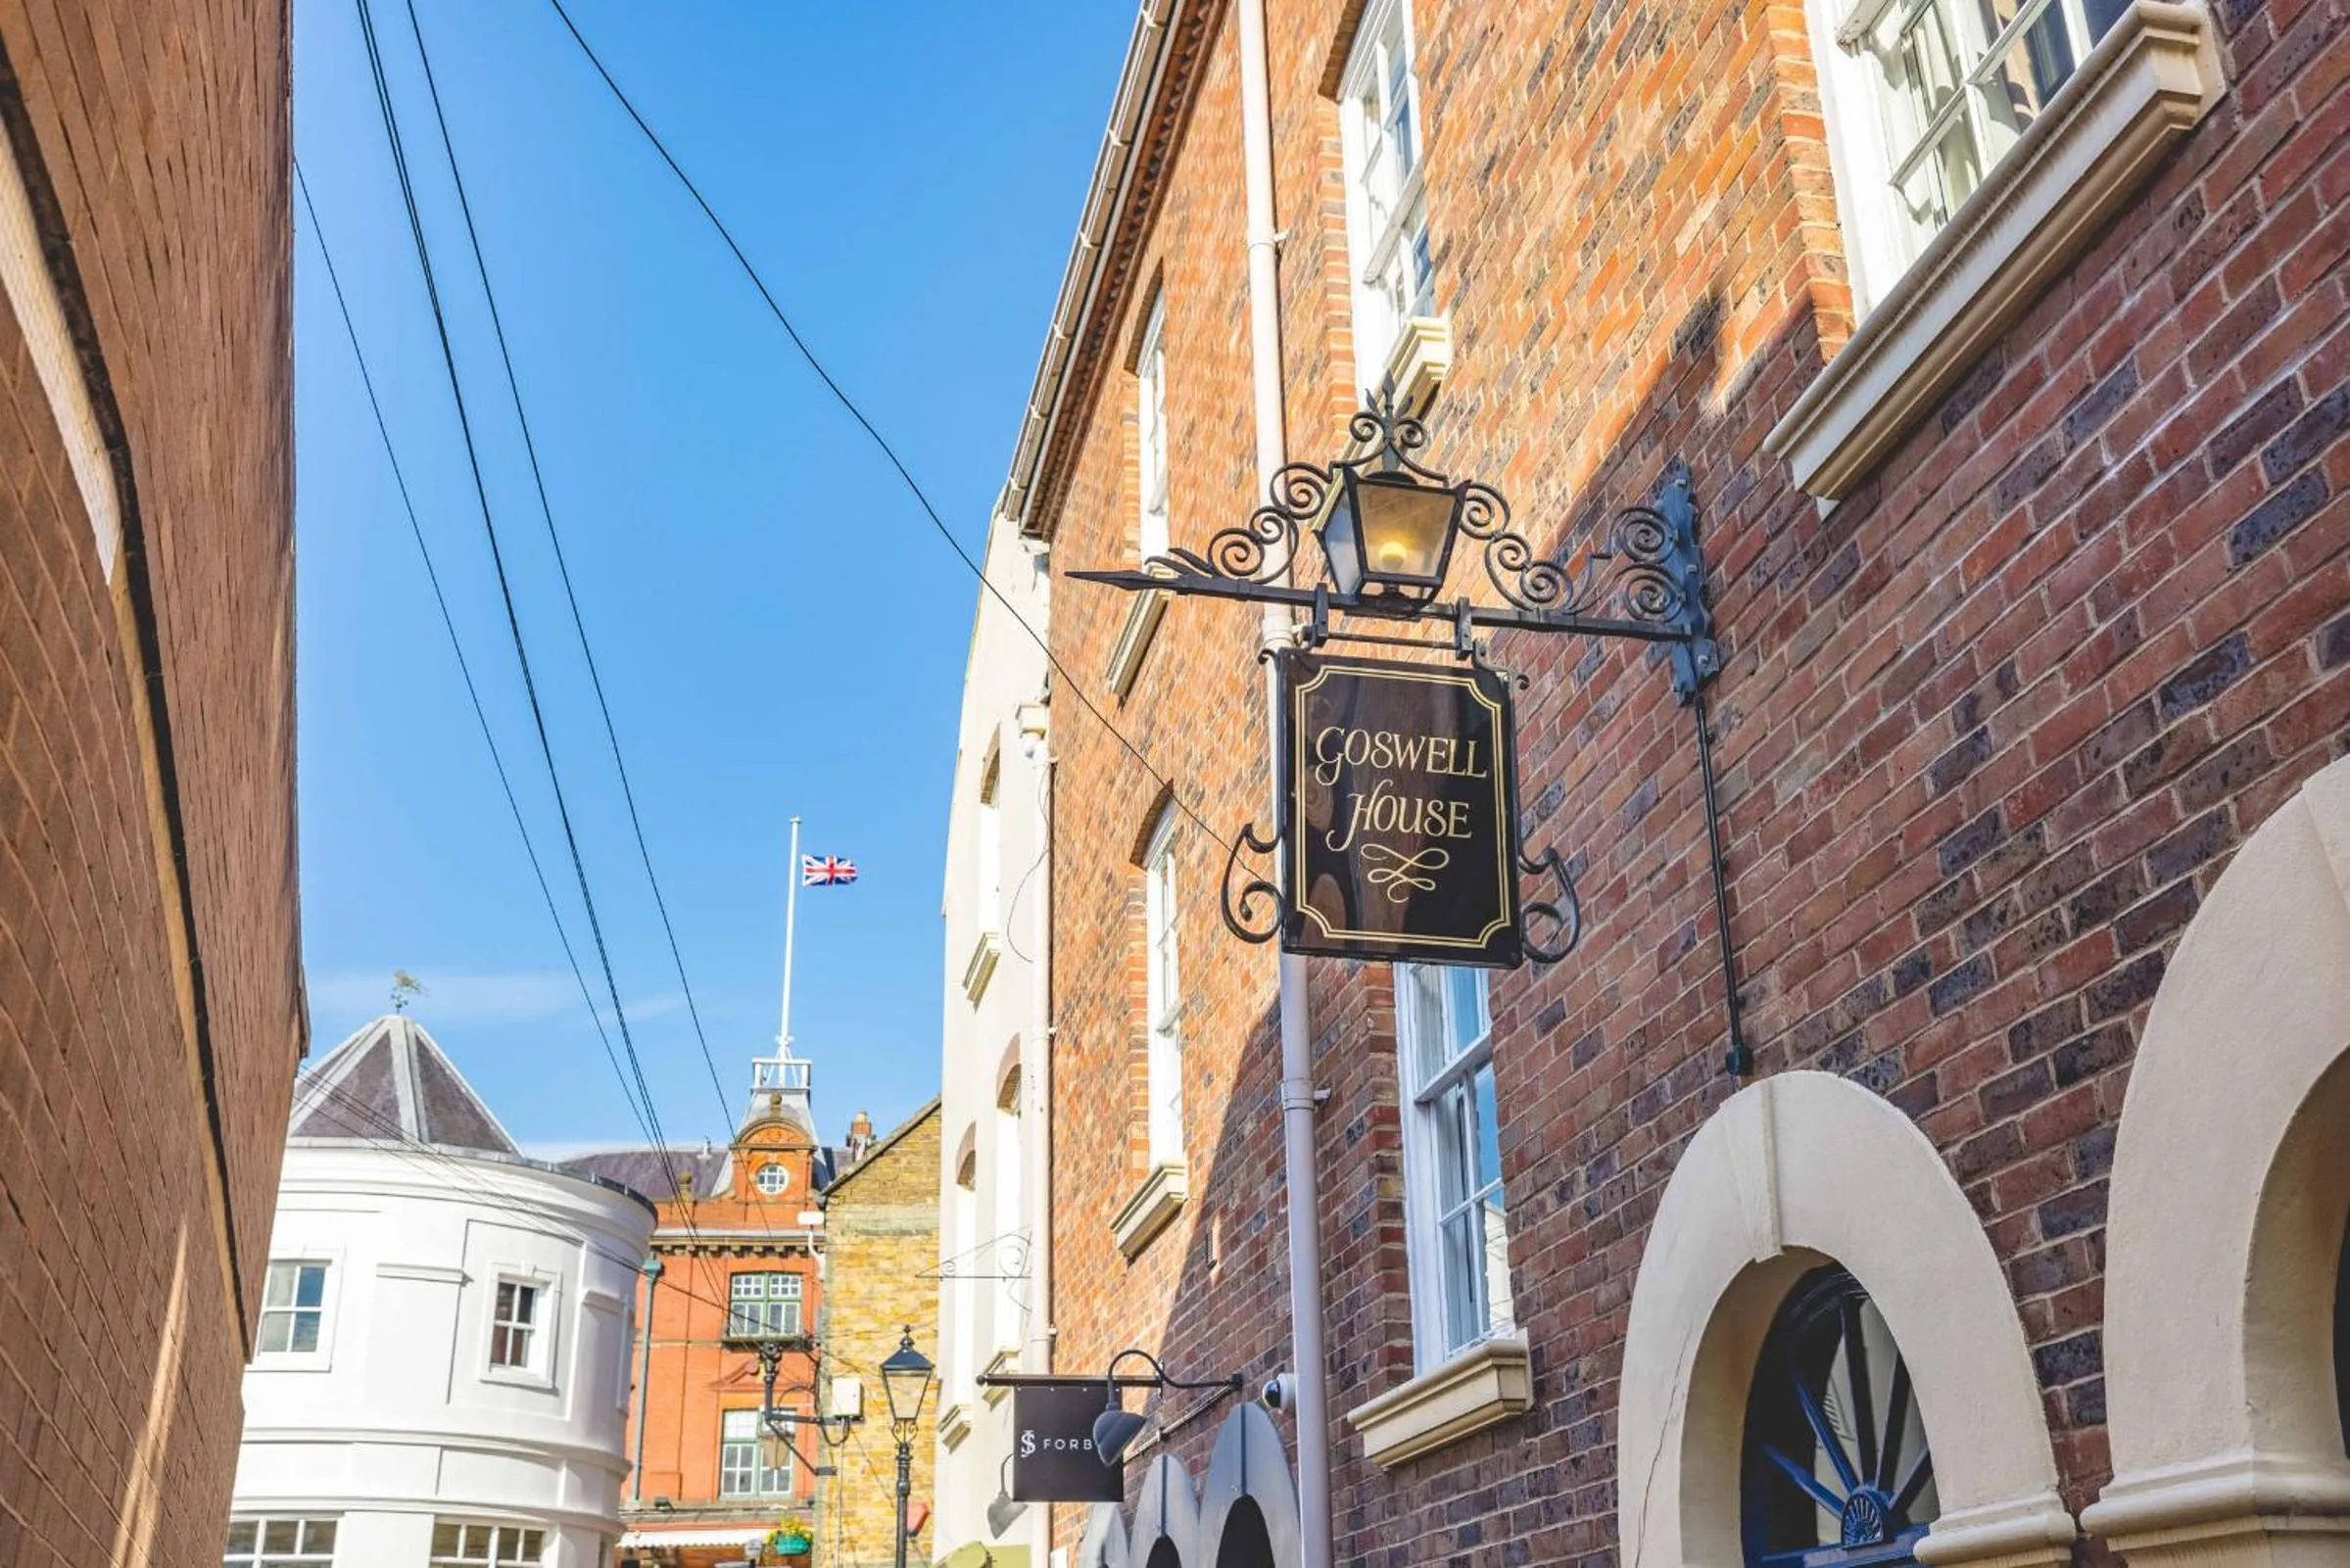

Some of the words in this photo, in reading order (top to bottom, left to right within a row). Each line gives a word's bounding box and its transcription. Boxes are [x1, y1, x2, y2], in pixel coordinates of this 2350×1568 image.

[1315, 726, 1488, 785] GOSWELL
[1325, 779, 1472, 852] HOUSE
[1043, 1438, 1093, 1450] FORB
